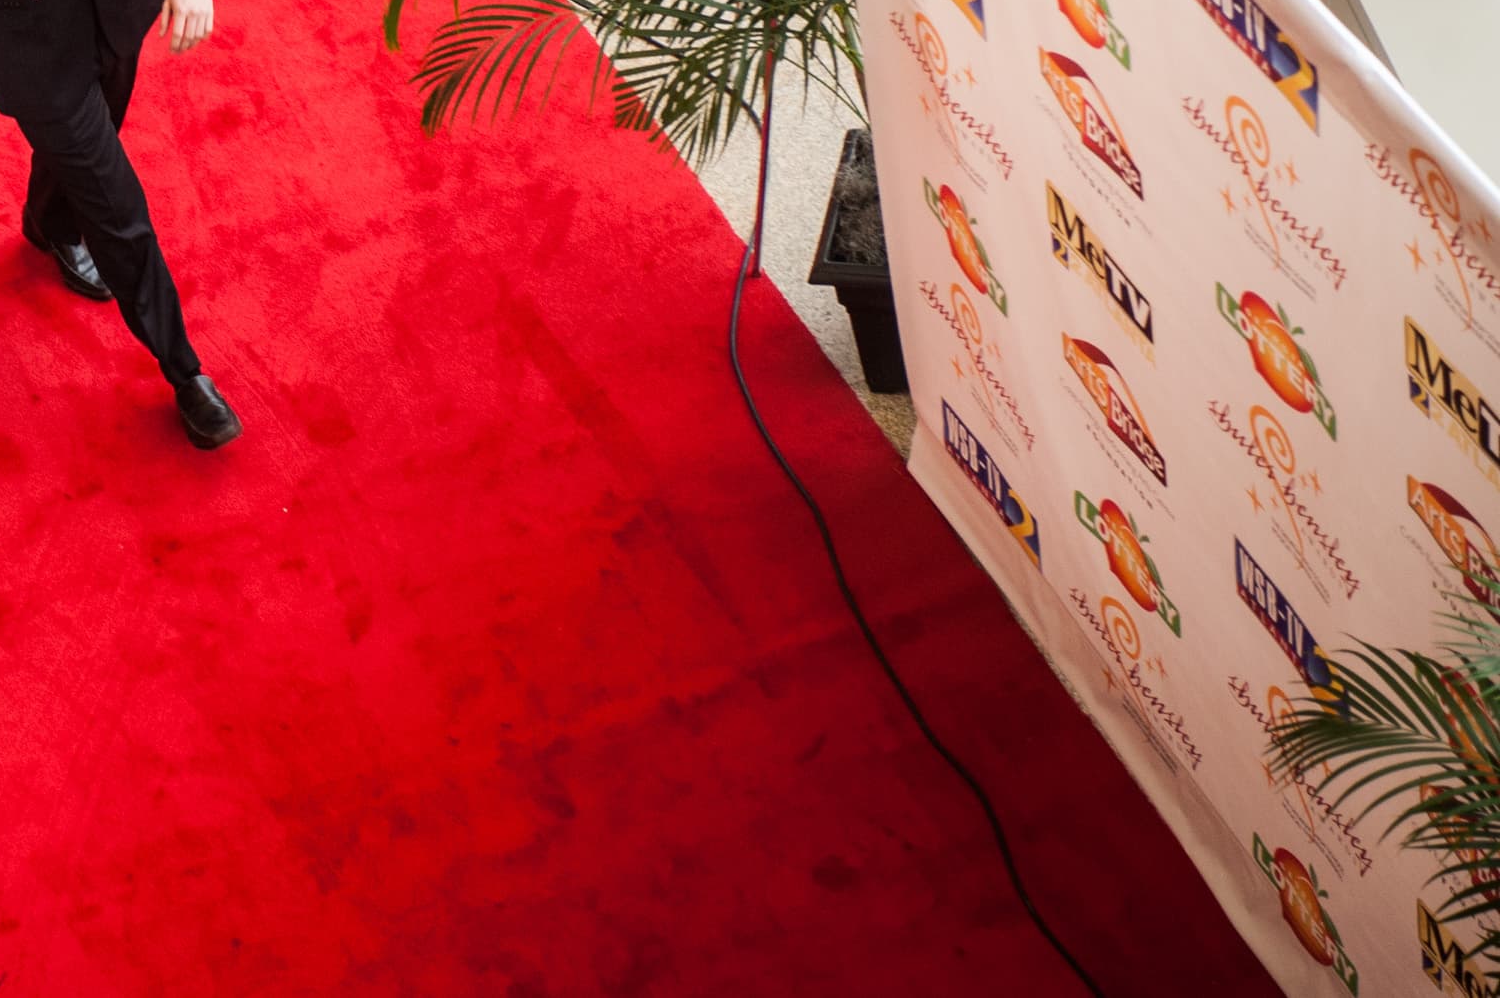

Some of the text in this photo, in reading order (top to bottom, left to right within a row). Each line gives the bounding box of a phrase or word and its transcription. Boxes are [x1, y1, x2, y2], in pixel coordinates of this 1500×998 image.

[1277, 29, 1318, 132] 2
[925, 183, 1006, 309] LOTTERY
[1052, 192, 1151, 331] MeTV
[1257, 171, 1348, 291] hensley
[1221, 288, 1334, 433] LOTTERY
[1078, 496, 1179, 631] LOTTERY
[1283, 478, 1361, 601] hensley
[1128, 662, 1202, 771] hensley
[1256, 839, 1358, 987] LOTTERY
